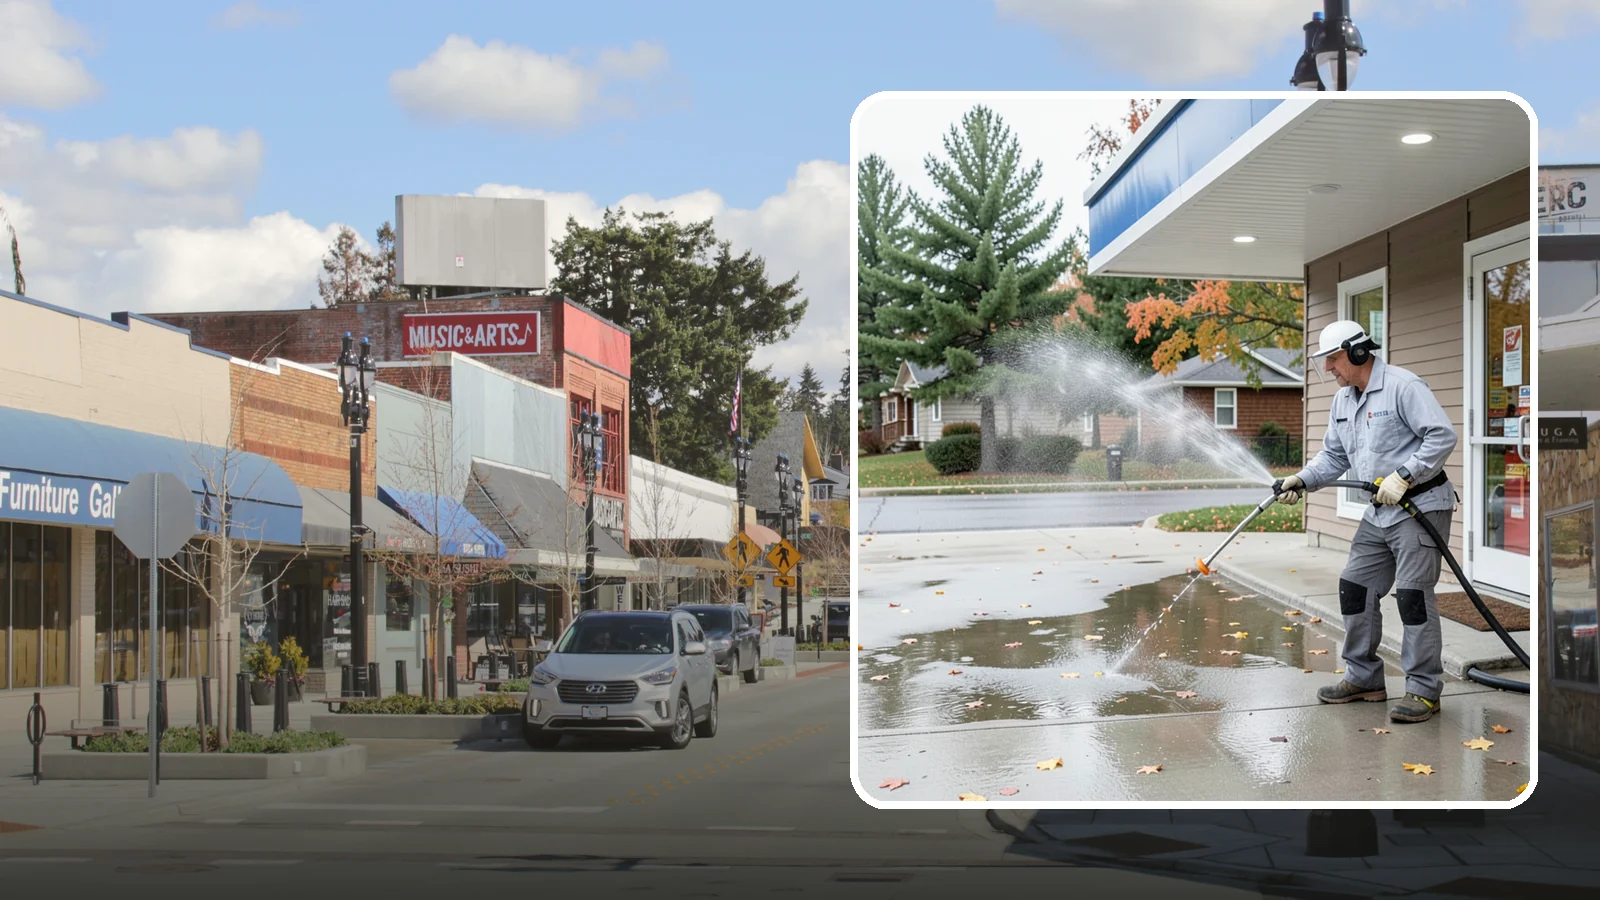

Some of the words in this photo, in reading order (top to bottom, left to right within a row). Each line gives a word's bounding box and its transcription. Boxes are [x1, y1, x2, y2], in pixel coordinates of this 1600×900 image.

[409, 323, 520, 349] MUSIC&ARTS
[1540, 428, 1577, 436] UGA
[0, 472, 79, 515] Furniture
[453, 563, 480, 573] SUSHI
